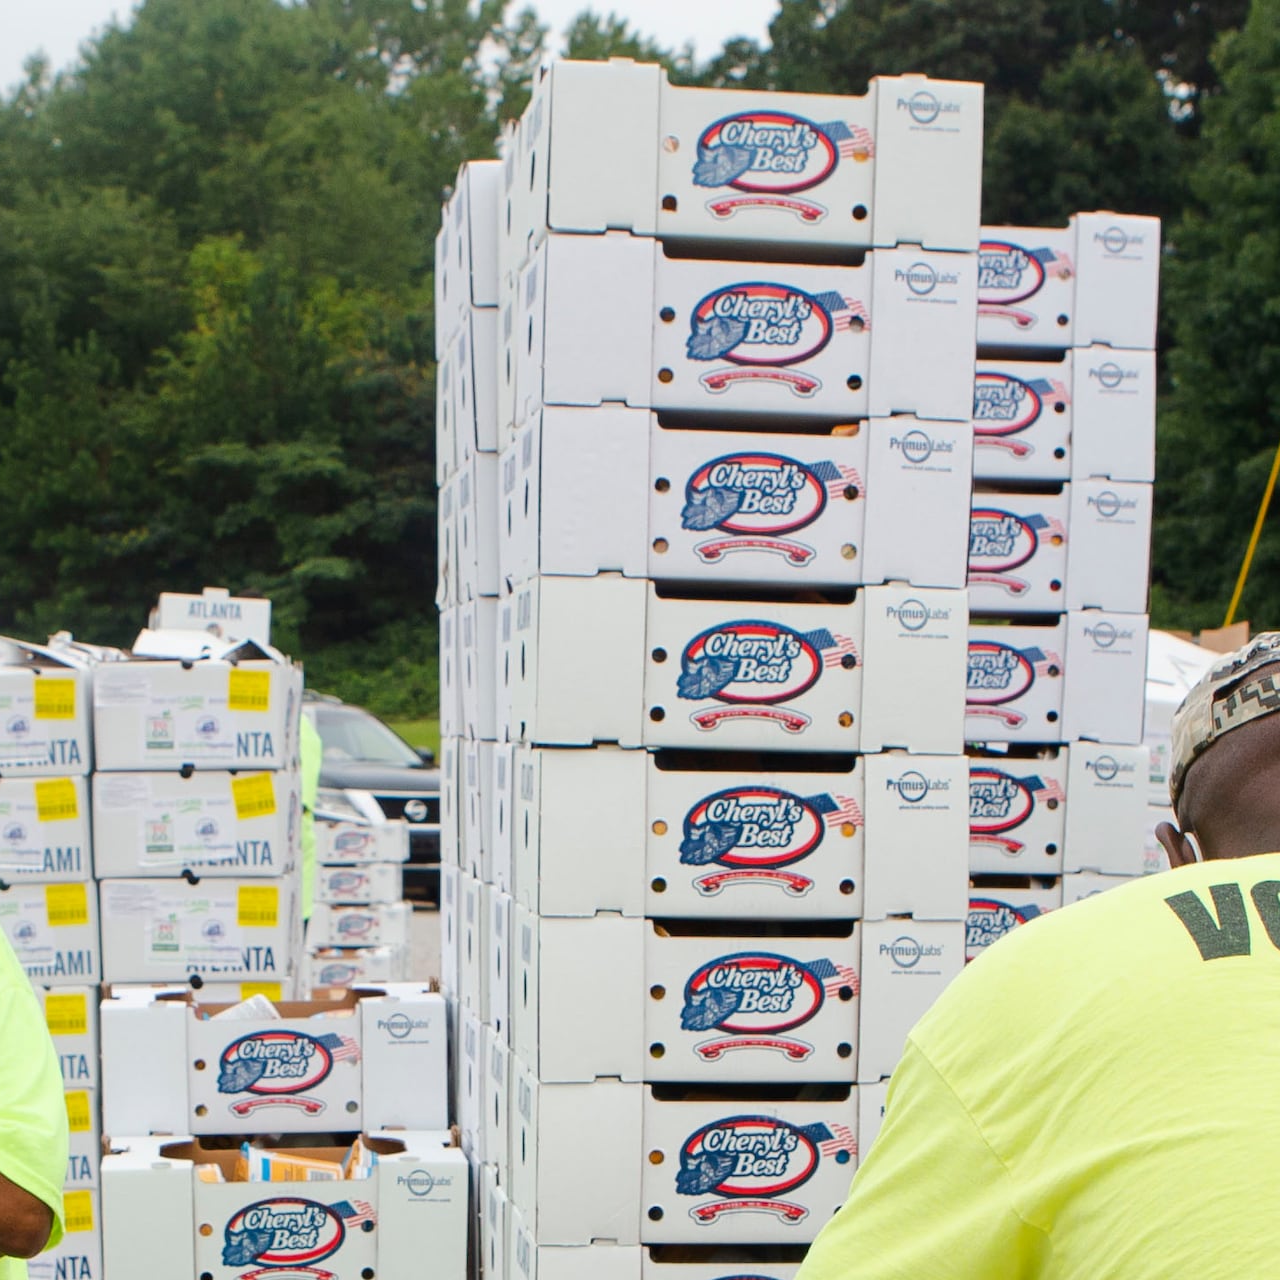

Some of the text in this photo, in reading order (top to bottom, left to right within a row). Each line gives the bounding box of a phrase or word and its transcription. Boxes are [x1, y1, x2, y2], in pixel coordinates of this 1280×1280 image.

[720, 120, 819, 151] Cheryl's
[751, 148, 806, 172] Best
[979, 249, 1031, 273] eryl's
[713, 293, 813, 326] Cheryl's
[745, 321, 801, 345] Best
[974, 380, 1026, 405] eryl's
[708, 463, 807, 494] Cheryl's
[739, 490, 795, 514] Best
[970, 516, 1023, 540] eryl's
[187, 600, 243, 619] ATLANTA
[704, 633, 802, 663] Cheryl's
[735, 659, 790, 682] Best
[967, 650, 1019, 674] eryl's
[968, 779, 1018, 803] eryl's
[706, 798, 803, 828] Cheryl's
[738, 823, 793, 847] Best
[966, 907, 1017, 931] eryl's
[706, 964, 804, 993] Cheryl's
[738, 989, 794, 1013] Best
[237, 1038, 317, 1063] Cheryl's
[262, 1058, 309, 1079] Best
[702, 1127, 800, 1157] Cheryl's
[734, 1152, 789, 1176] Best
[243, 1206, 329, 1231] Cheryl's
[270, 1228, 319, 1251] Best
